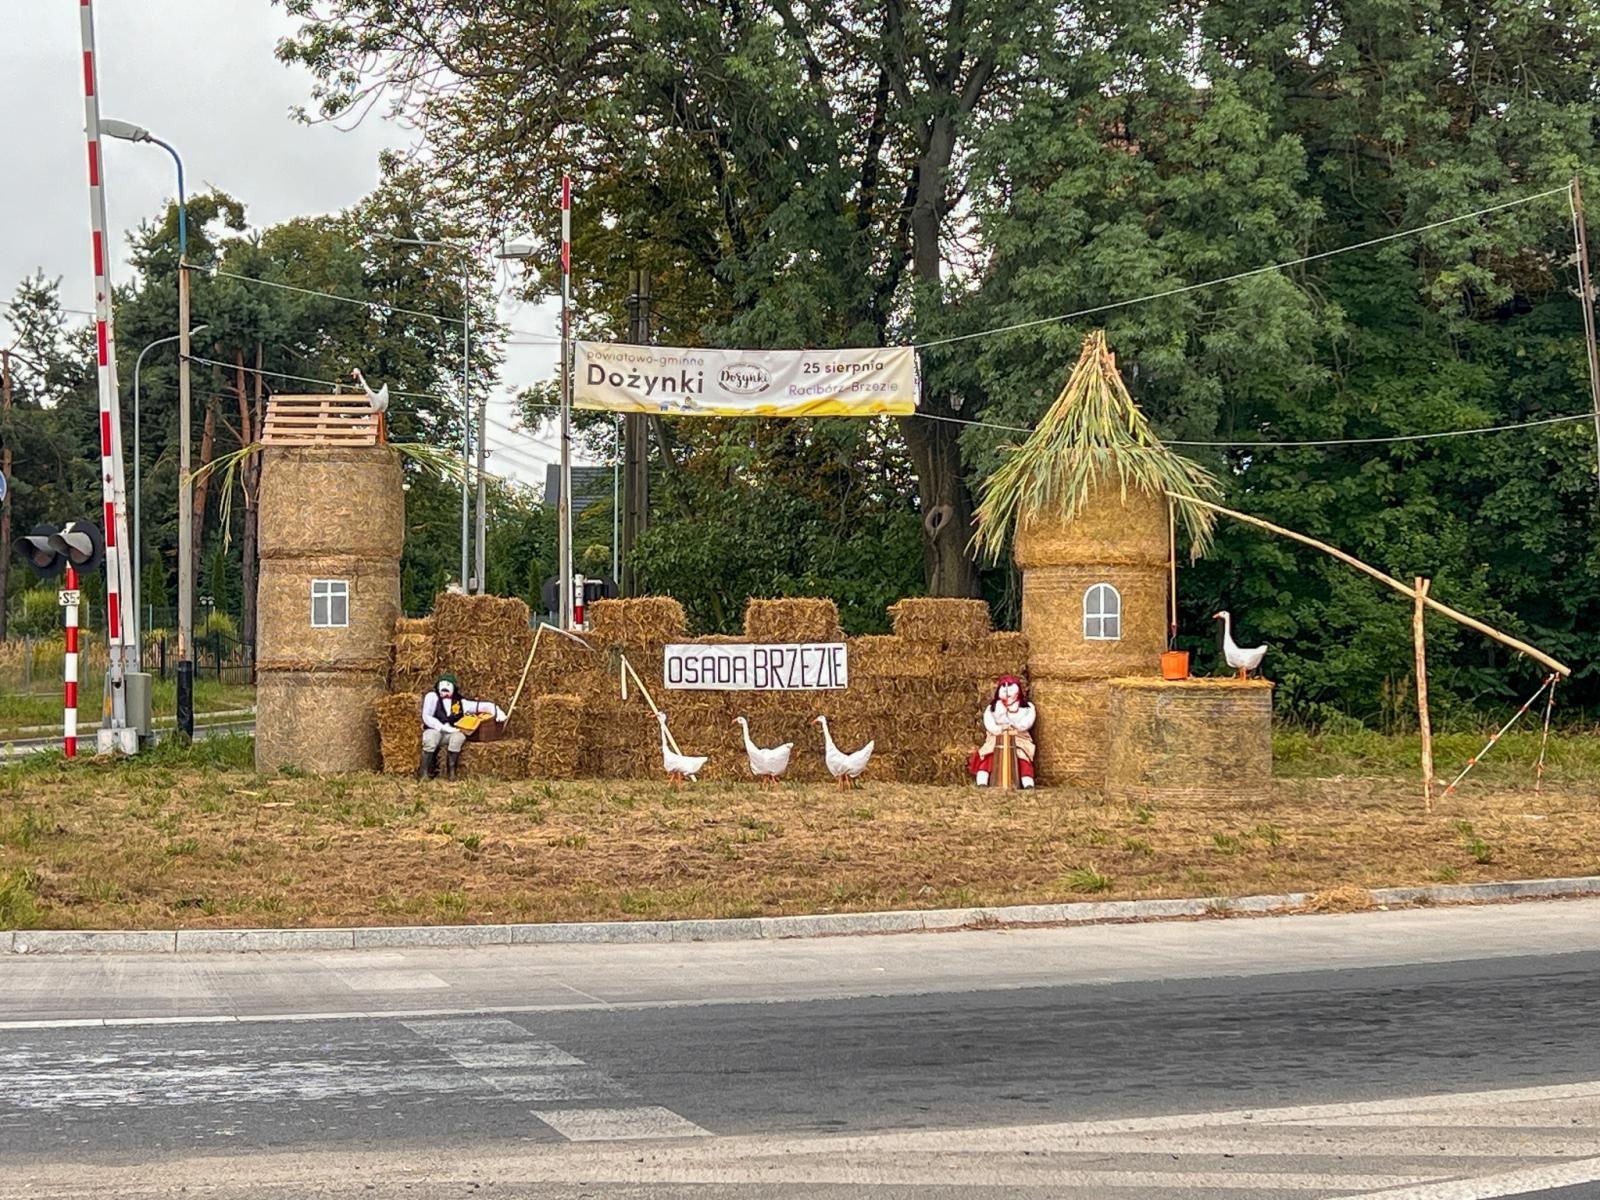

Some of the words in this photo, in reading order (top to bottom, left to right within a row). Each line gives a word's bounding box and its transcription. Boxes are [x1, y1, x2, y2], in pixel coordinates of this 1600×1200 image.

[586, 350, 705, 367] powiatowo-gminne
[803, 362, 820, 374] 25
[825, 361, 884, 376] sierpnia
[587, 364, 704, 396] Dożynki
[789, 382, 898, 396] Racibórz-Brzezie
[668, 655, 747, 684] OSADA
[754, 647, 846, 688] BRZEZIE
